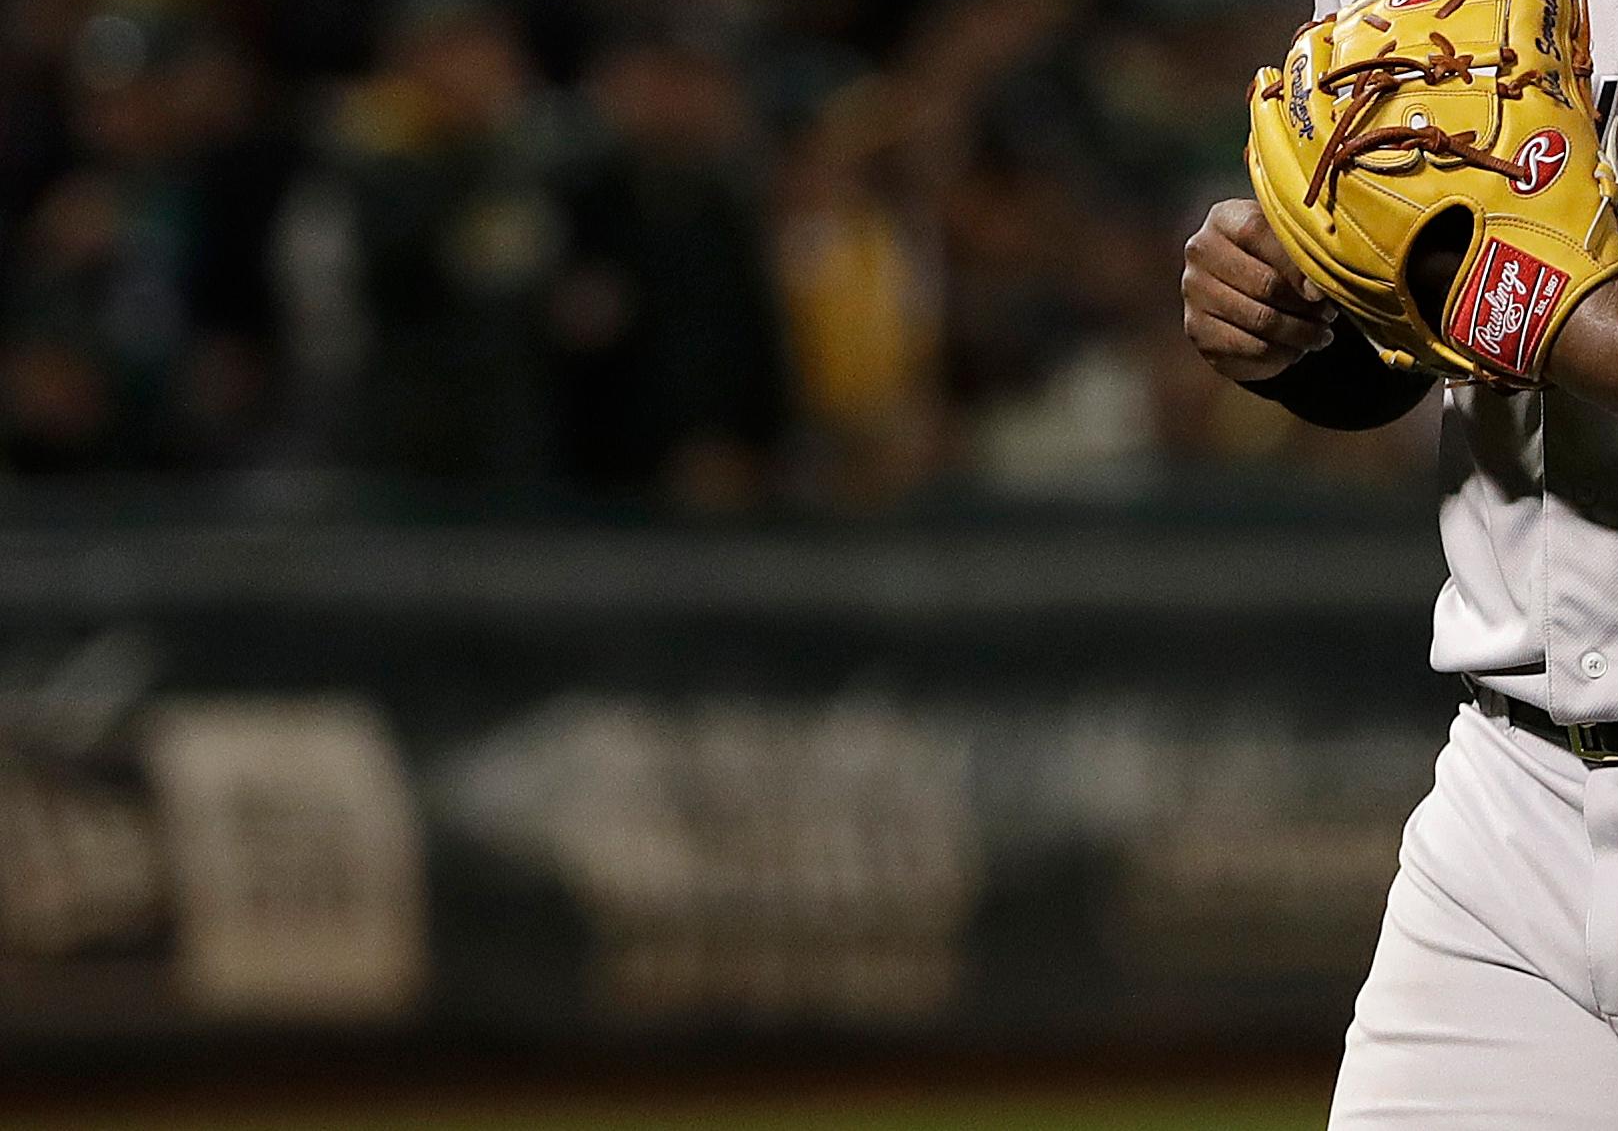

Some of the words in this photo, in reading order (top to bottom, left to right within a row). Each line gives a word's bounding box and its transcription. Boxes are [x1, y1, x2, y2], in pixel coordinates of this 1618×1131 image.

[1516, 136, 1564, 191] R
[1475, 260, 1527, 354] Rawlings
[1534, 298, 1550, 316] Est.
